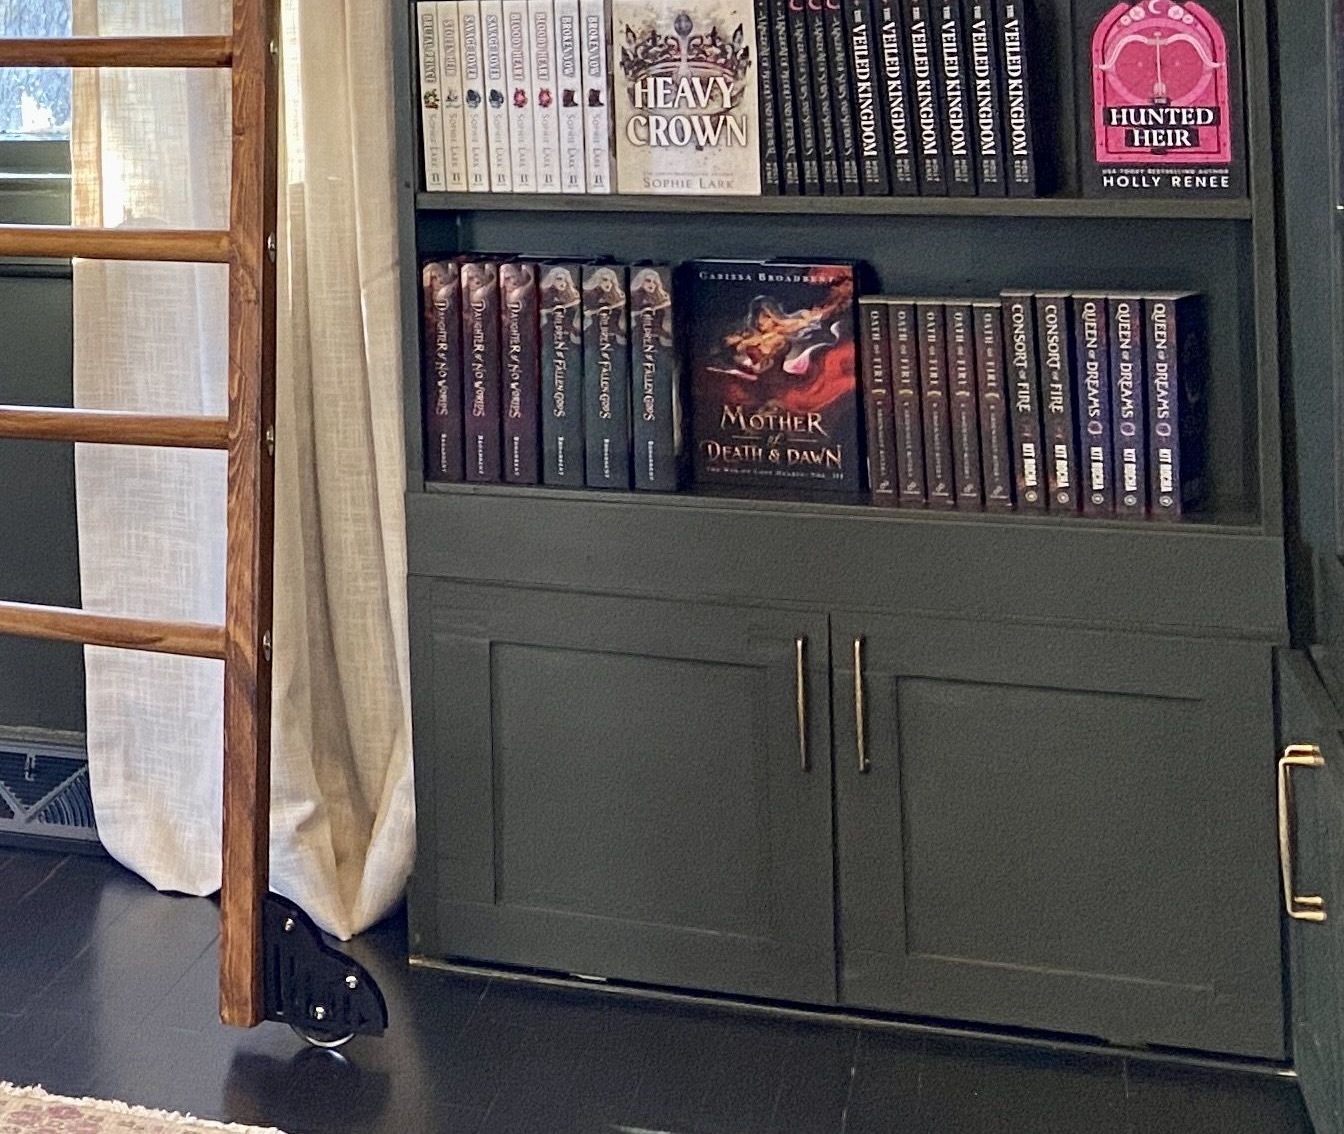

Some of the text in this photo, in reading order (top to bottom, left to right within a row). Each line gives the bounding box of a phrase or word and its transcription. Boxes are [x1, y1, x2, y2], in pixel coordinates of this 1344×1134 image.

[633, 77, 736, 109] HEAVY
[853, 24, 878, 156] VEILED KINGDOM
[882, 21, 908, 155] VEILED KINGDOM
[625, 115, 749, 148] CROWN
[1110, 108, 1214, 125] HUNTED
[1133, 130, 1192, 146] HEIR
[643, 177, 735, 190] SOPHIE LARK
[1103, 176, 1230, 187] HOLLY RENEE
[699, 271, 752, 281] CARISSA
[1082, 302, 1097, 348] QUEEN
[1012, 304, 1031, 414] CONSORT FIRE
[1085, 361, 1100, 418] DREAMS
[720, 404, 828, 436] MOTHER
[704, 441, 842, 469] DEATH & DAWN
